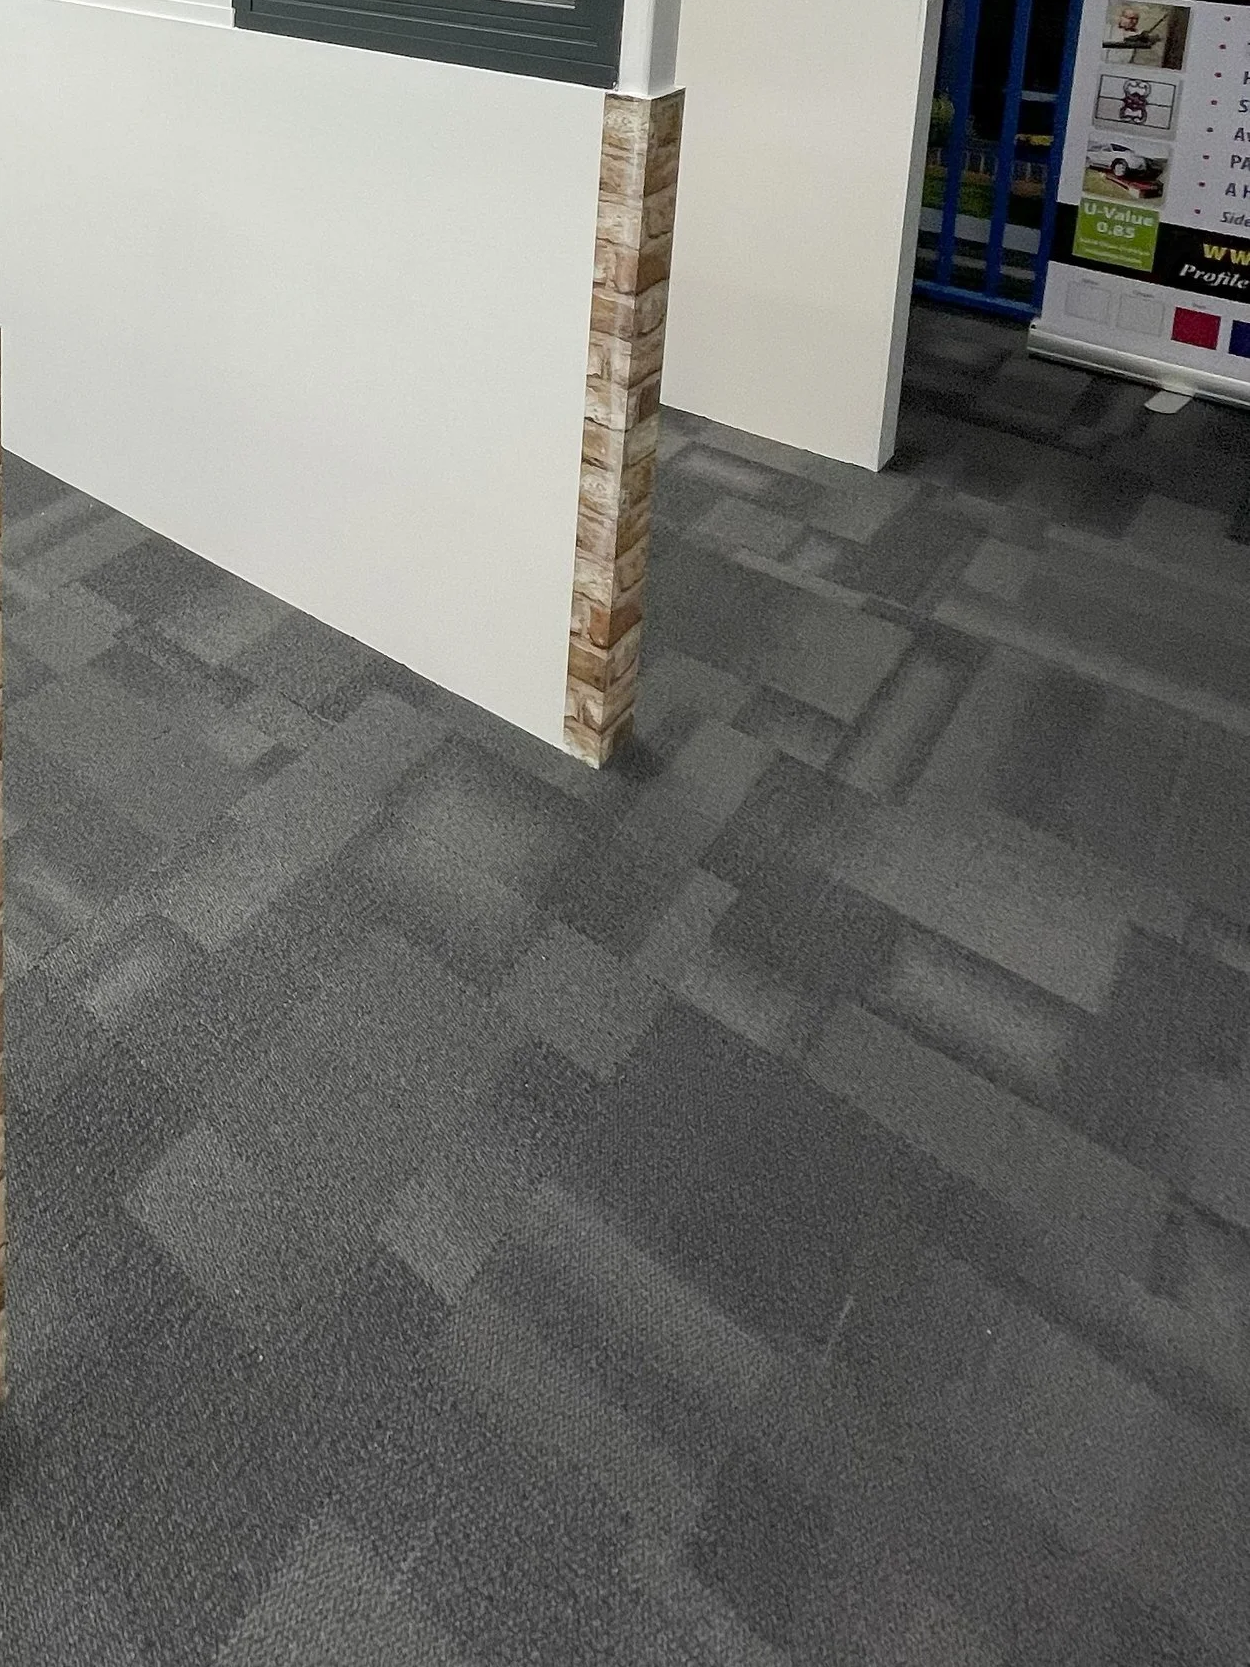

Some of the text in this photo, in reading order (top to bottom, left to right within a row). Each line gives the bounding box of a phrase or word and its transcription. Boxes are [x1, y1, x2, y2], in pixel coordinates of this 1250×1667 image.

[1225, 181, 1236, 198] A
[1083, 201, 1155, 227] U-Value
[1179, 263, 1250, 289] Profile
